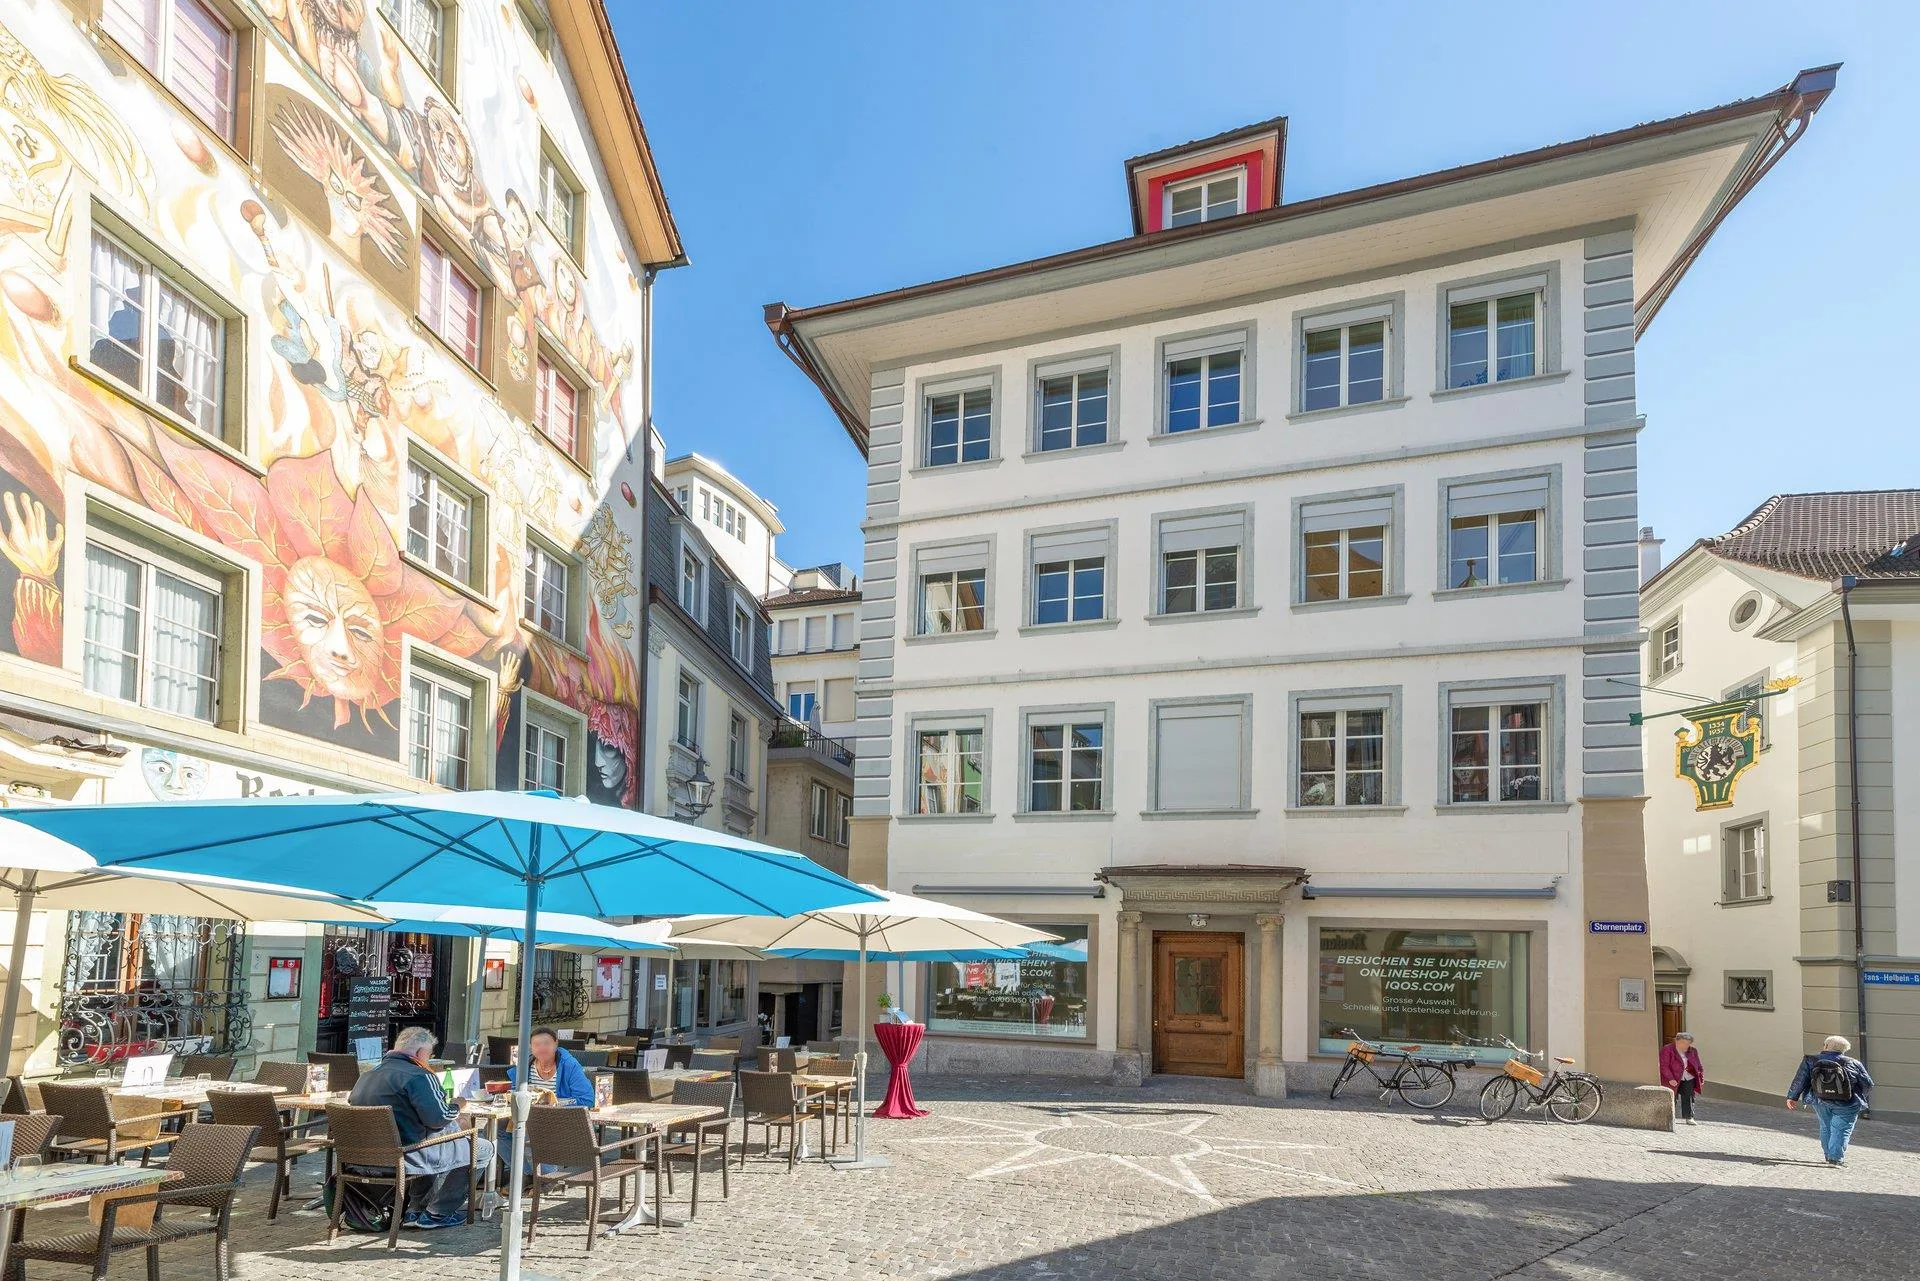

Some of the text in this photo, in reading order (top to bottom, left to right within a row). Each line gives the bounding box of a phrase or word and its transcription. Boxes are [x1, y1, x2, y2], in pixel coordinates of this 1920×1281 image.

[1594, 922, 1642, 932] Sternenplatz
[1337, 955, 1507, 969] BESUCHEN SIE UNSEREN
[1360, 968, 1483, 981] ONLINESHOP AUF
[1385, 981, 1455, 992] IQOS.COM
[1383, 996, 1458, 1006] Grosse Auswahl.
[1342, 1003, 1500, 1018] Schnelle und kostenlose Lieferung.
